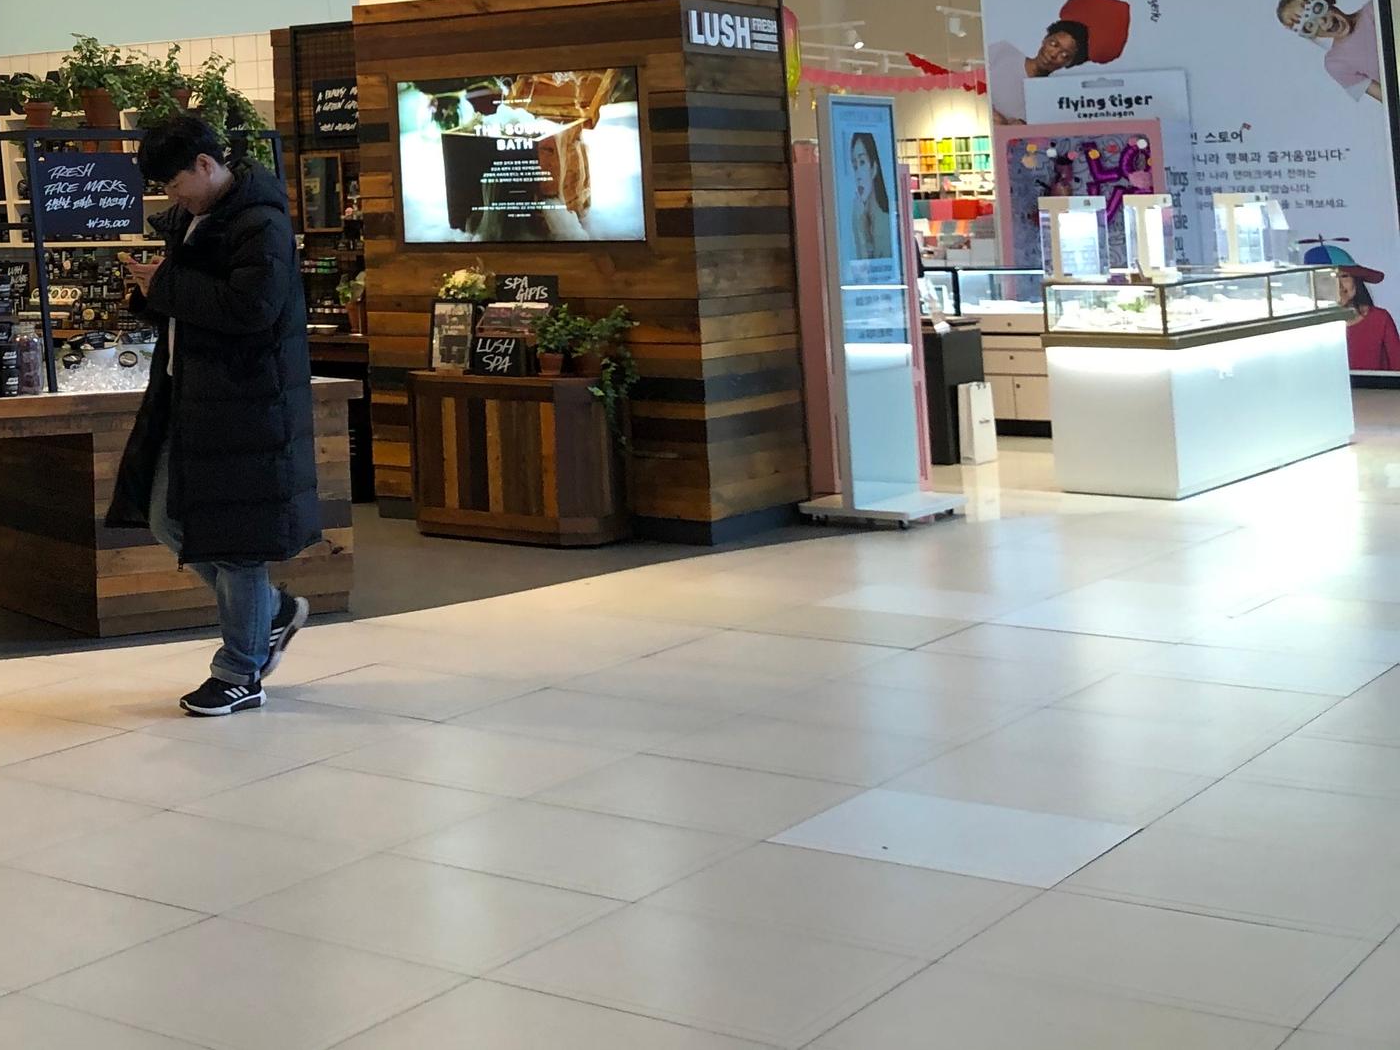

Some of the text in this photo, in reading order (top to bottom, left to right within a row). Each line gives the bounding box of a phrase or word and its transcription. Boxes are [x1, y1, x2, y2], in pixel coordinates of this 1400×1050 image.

[687, 9, 751, 49] LUSH
[1057, 93, 1153, 112] flying tiger
[1077, 110, 1135, 119] copenhagen
[496, 138, 534, 151] BATH
[47, 162, 96, 181] FRESH
[43, 179, 128, 196] FACE MASKS
[503, 275, 529, 290] SPA
[515, 285, 549, 303] GIFTS
[476, 337, 516, 354] LUSH
[481, 353, 514, 373] SPA
